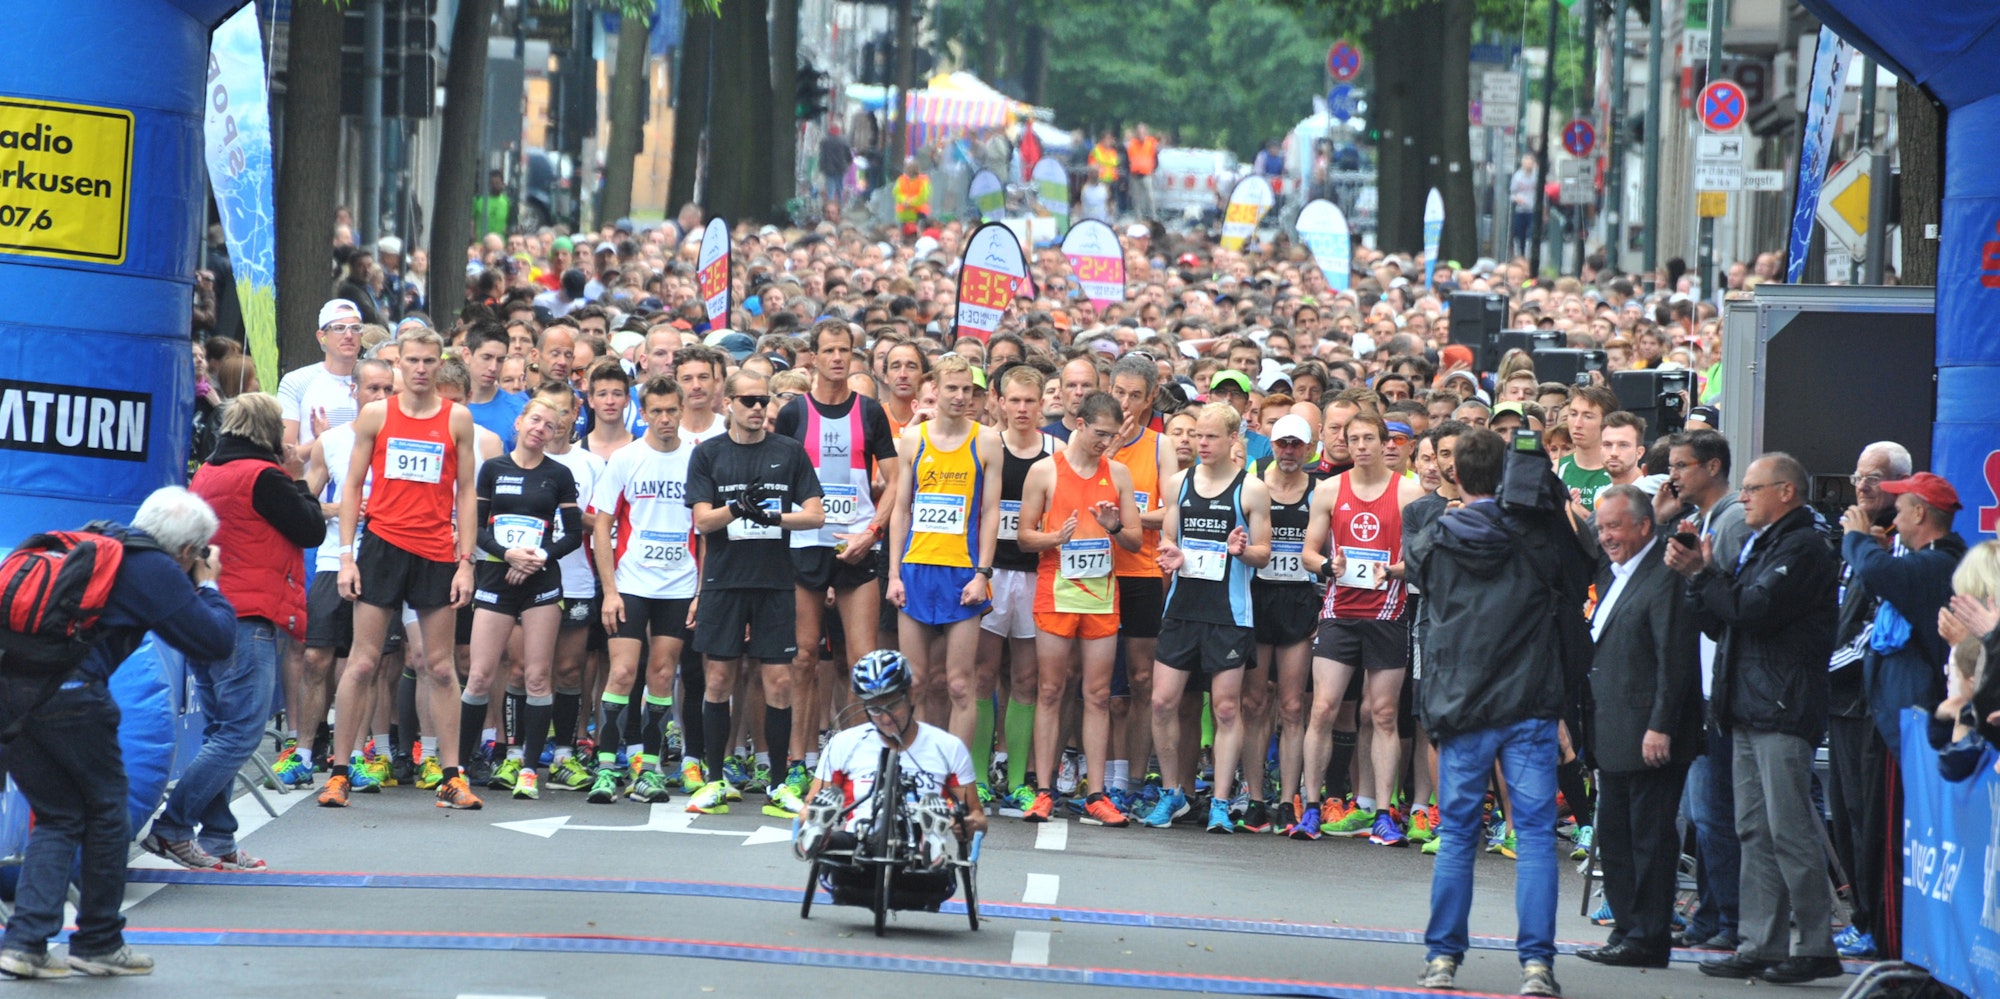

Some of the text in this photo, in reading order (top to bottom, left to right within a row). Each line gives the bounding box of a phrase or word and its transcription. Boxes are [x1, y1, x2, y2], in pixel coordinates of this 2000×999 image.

[962, 269, 1008, 308] 1:35
[0, 388, 146, 453] ATURN
[398, 454, 428, 472] 911
[823, 499, 851, 514] 500
[919, 508, 957, 524] 2224
[1184, 517, 1227, 530] ENGELS
[506, 529, 526, 543] 67
[644, 545, 683, 561] 2265
[1068, 553, 1105, 569] 1577
[1197, 554, 1204, 569] 1
[1270, 555, 1299, 572] 113
[1356, 563, 1367, 579] 2
